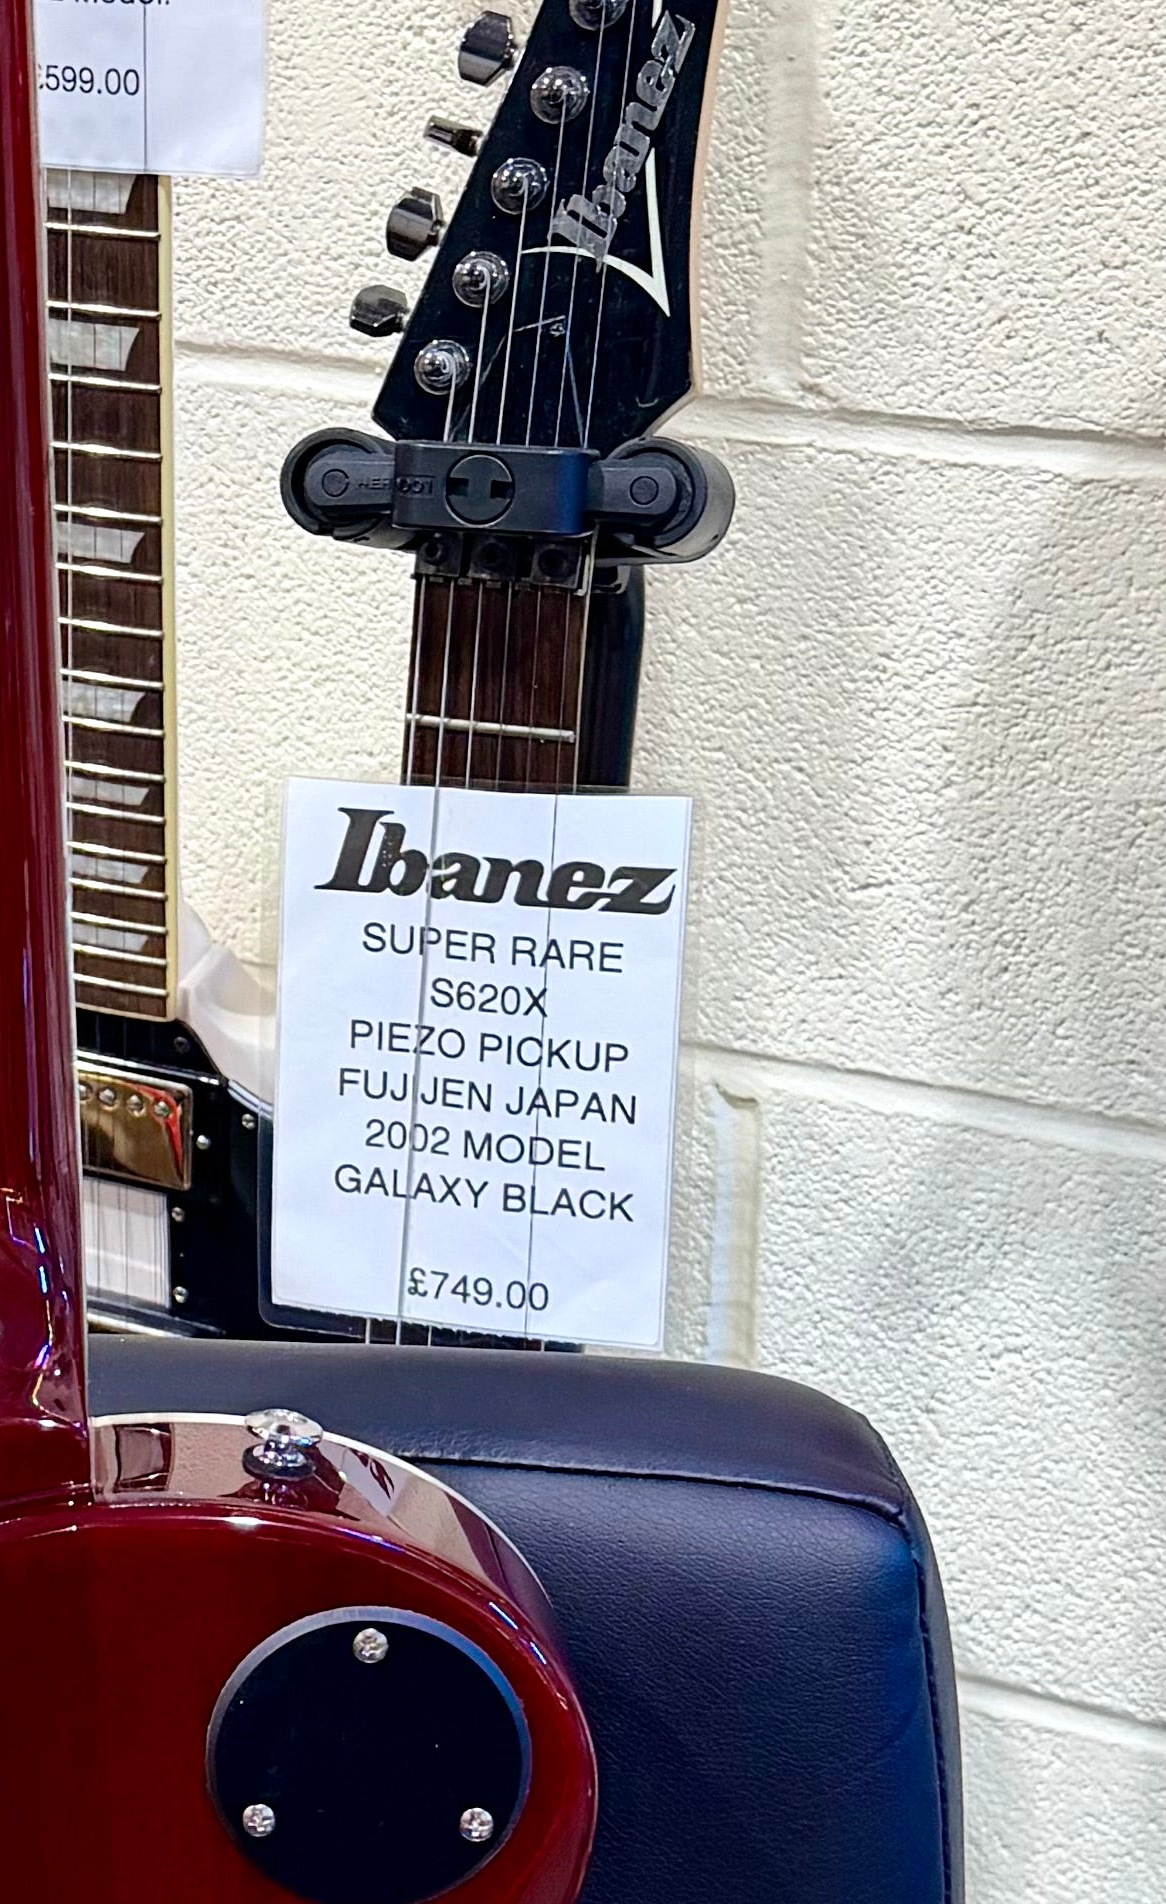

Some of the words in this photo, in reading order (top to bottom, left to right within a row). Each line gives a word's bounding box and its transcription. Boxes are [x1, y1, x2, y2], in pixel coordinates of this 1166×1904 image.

[547, 10, 695, 274] Ibanez
[314, 806, 678, 916] Ibanez
[363, 922, 496, 964] SUPER
[511, 936, 624, 973] RARE
[430, 978, 549, 1018] S620X
[350, 1020, 466, 1060] PIEZO
[479, 1035, 630, 1073] PICKUP
[506, 1086, 637, 1125] JAPAN
[365, 1119, 450, 1156] 2002
[463, 1130, 605, 1171] MODEL
[334, 1163, 488, 1209] GALAXY
[502, 1183, 634, 1223] BLACK
[407, 1267, 550, 1312] £749.00
